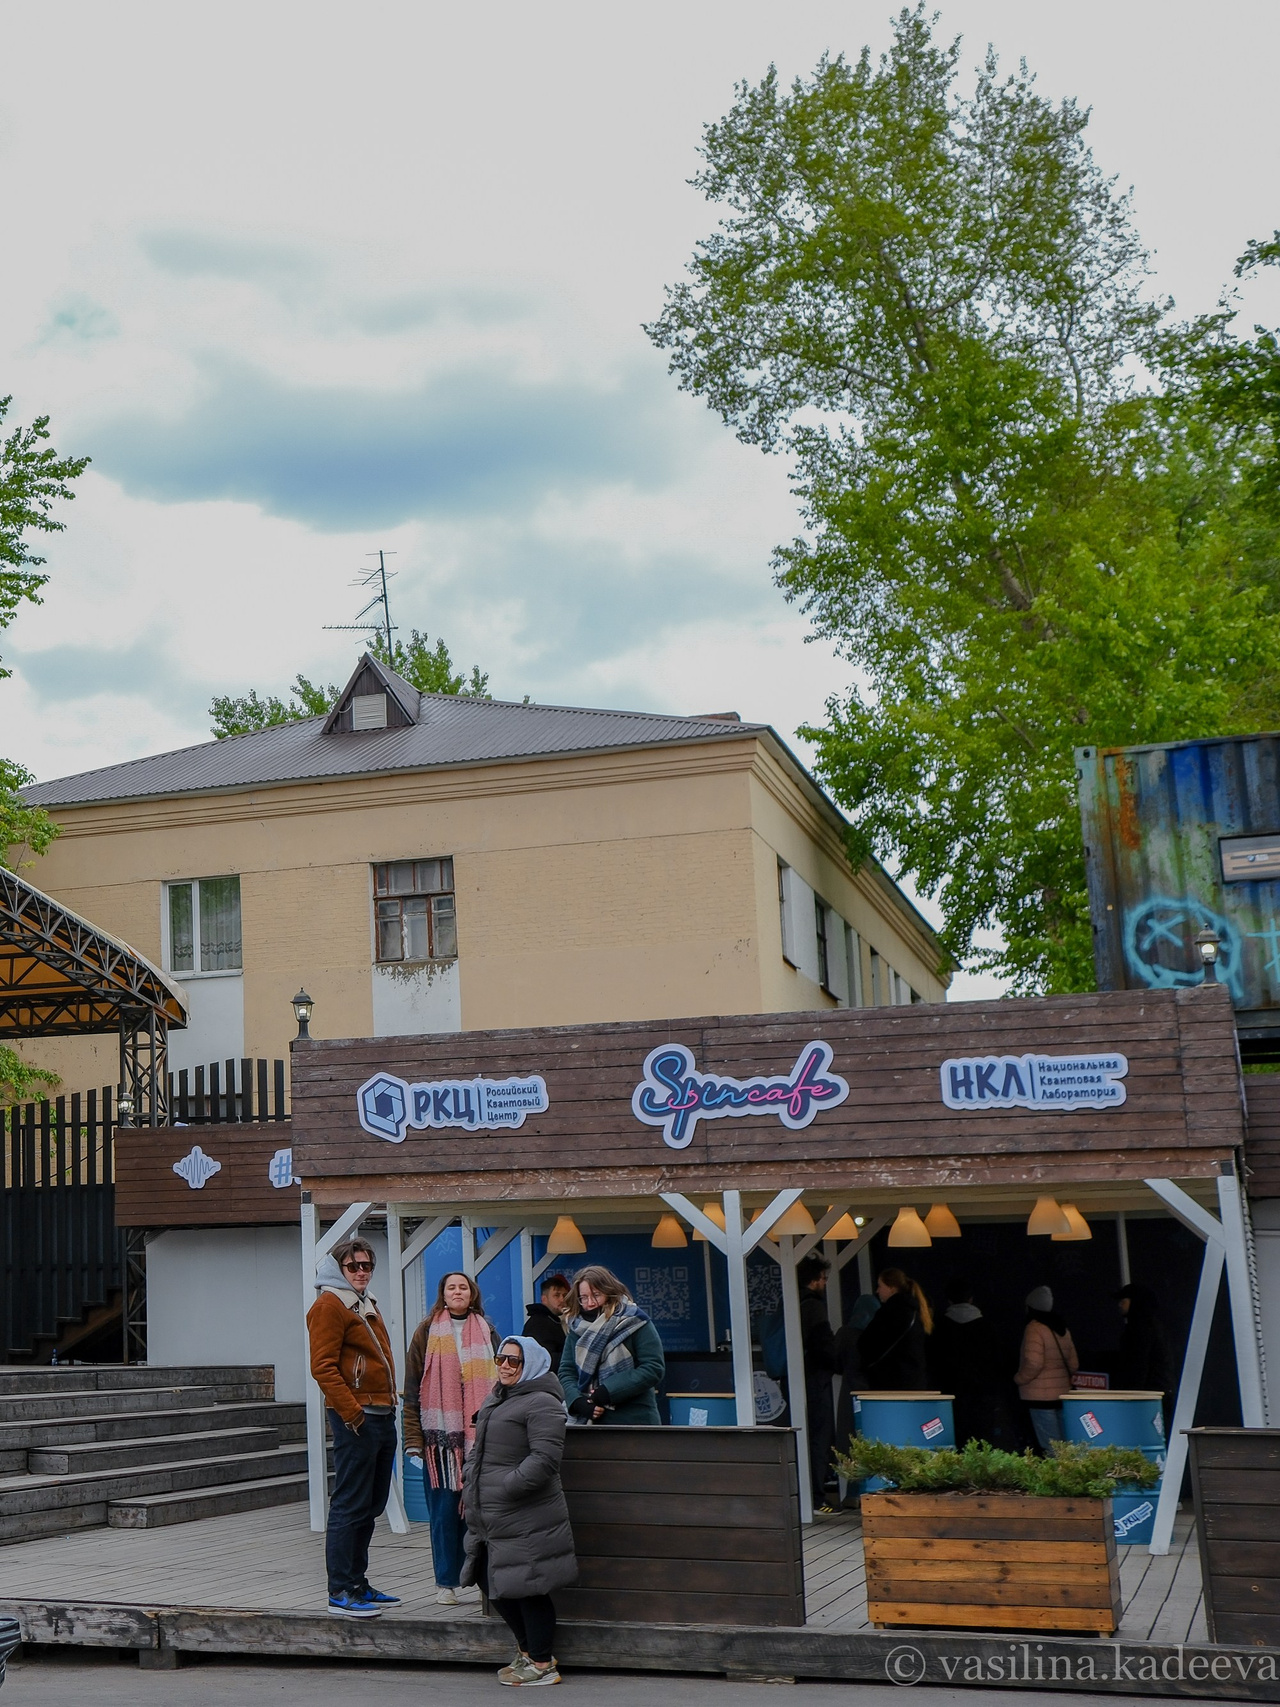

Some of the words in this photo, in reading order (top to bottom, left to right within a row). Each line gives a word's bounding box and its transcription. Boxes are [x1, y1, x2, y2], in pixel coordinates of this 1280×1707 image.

[1038, 1060, 1118, 1074] Национальная
[950, 1063, 1026, 1100] НКЛ
[1039, 1075, 1102, 1086] Квантовая
[486, 1084, 538, 1097] Российский
[1041, 1087, 1117, 1100] Лаборатория
[413, 1087, 475, 1124] РКЦ
[487, 1097, 541, 1109] Квантовый
[487, 1110, 518, 1122] Центр
[1071, 1374, 1106, 1388] CAUTION
[1122, 1513, 1141, 1528] РКЦ
